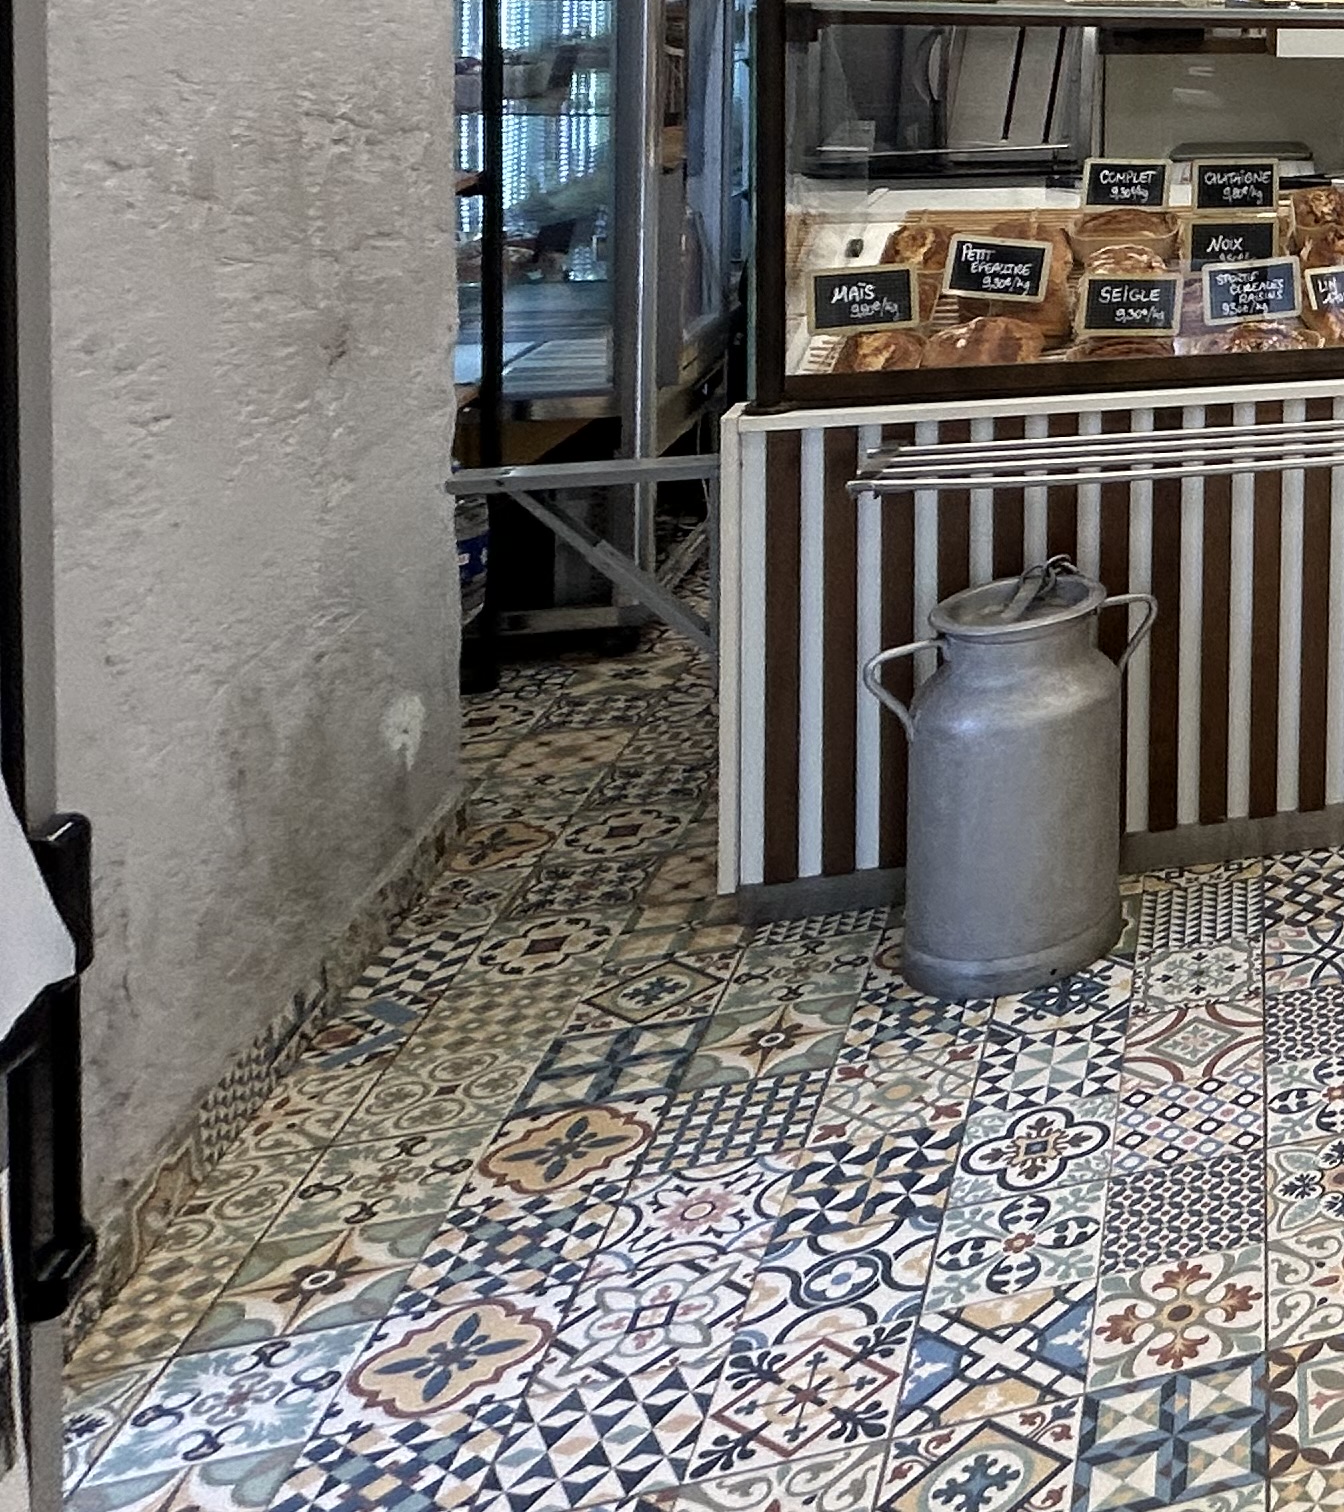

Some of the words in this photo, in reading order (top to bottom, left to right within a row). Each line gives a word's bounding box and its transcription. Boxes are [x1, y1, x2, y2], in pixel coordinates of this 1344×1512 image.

[1099, 168, 1157, 185] COMPLET
[961, 242, 996, 262] PETIT
[1206, 234, 1244, 253] NOIX
[831, 282, 876, 304] MAÏS
[1100, 285, 1161, 304] SEIGLE
[1317, 278, 1338, 292] LIN
